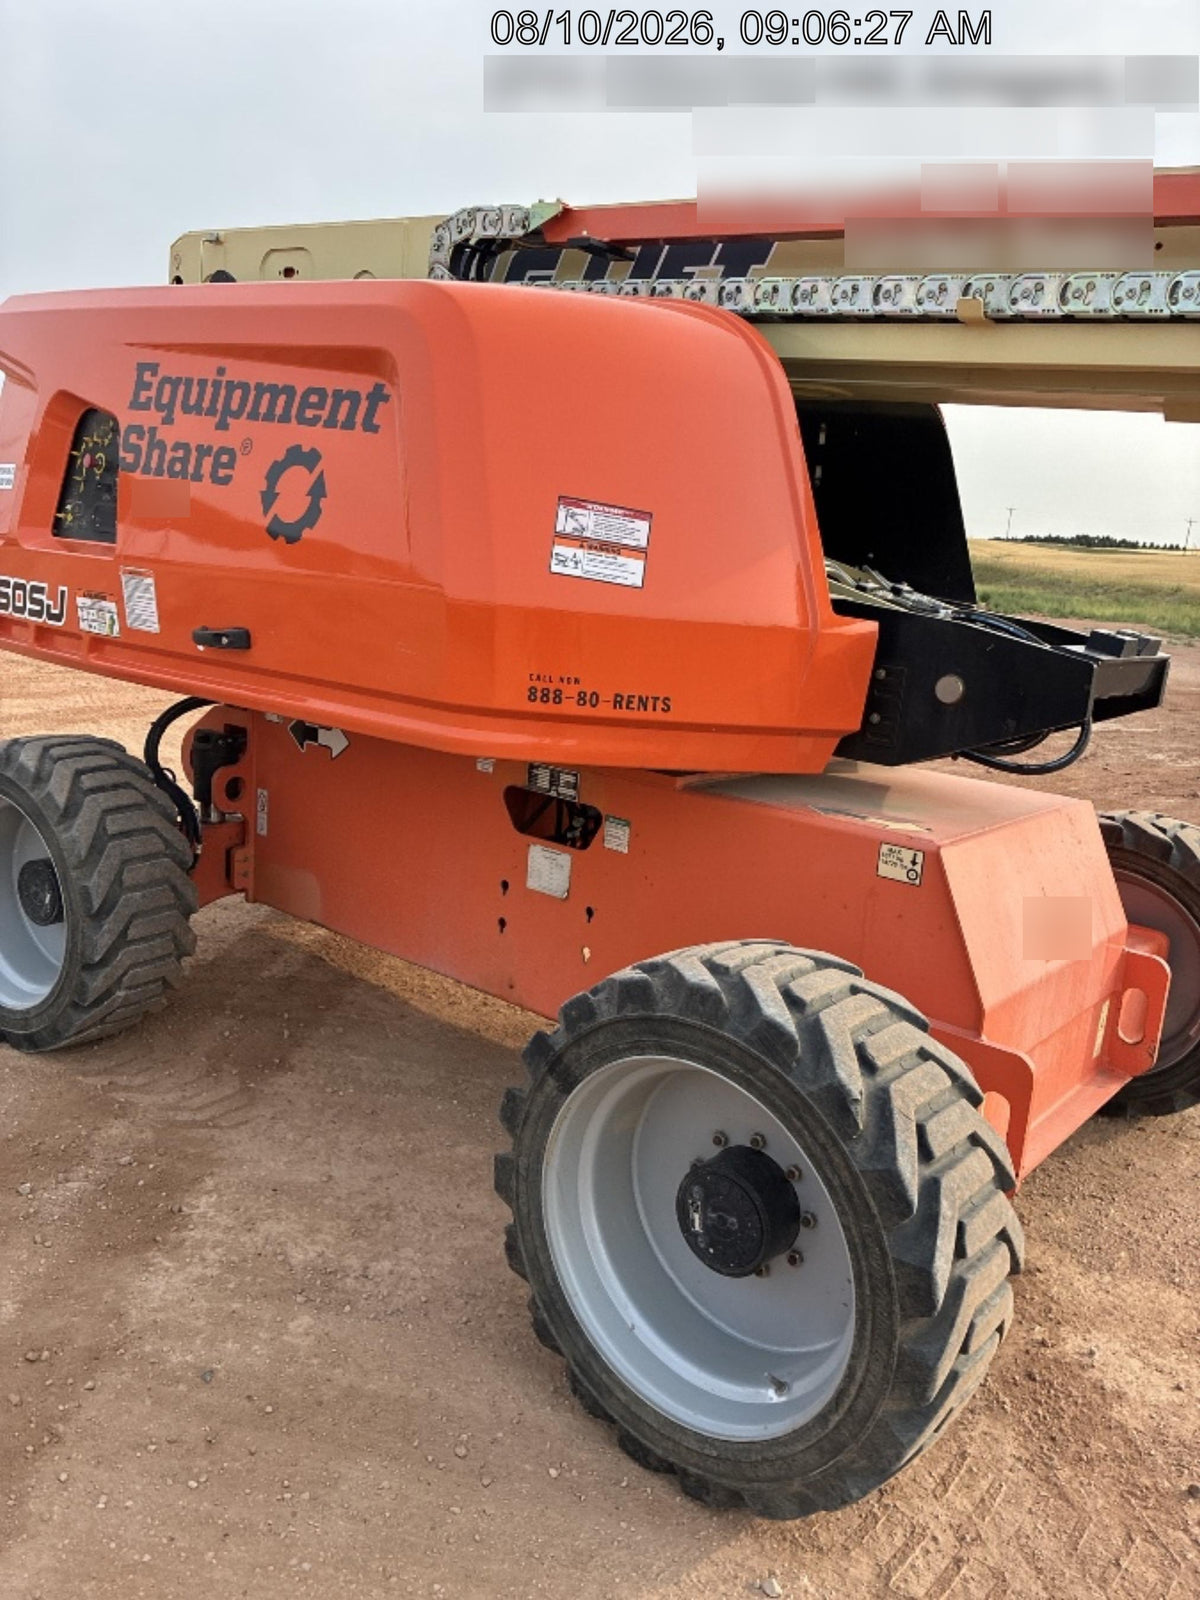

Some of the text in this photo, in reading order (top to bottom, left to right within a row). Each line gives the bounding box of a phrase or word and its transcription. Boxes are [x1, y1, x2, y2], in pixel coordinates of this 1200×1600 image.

[128, 362, 391, 434] Equipment
[529, 673, 553, 684] CALL
[527, 685, 671, 713] 888-80-RENTS
